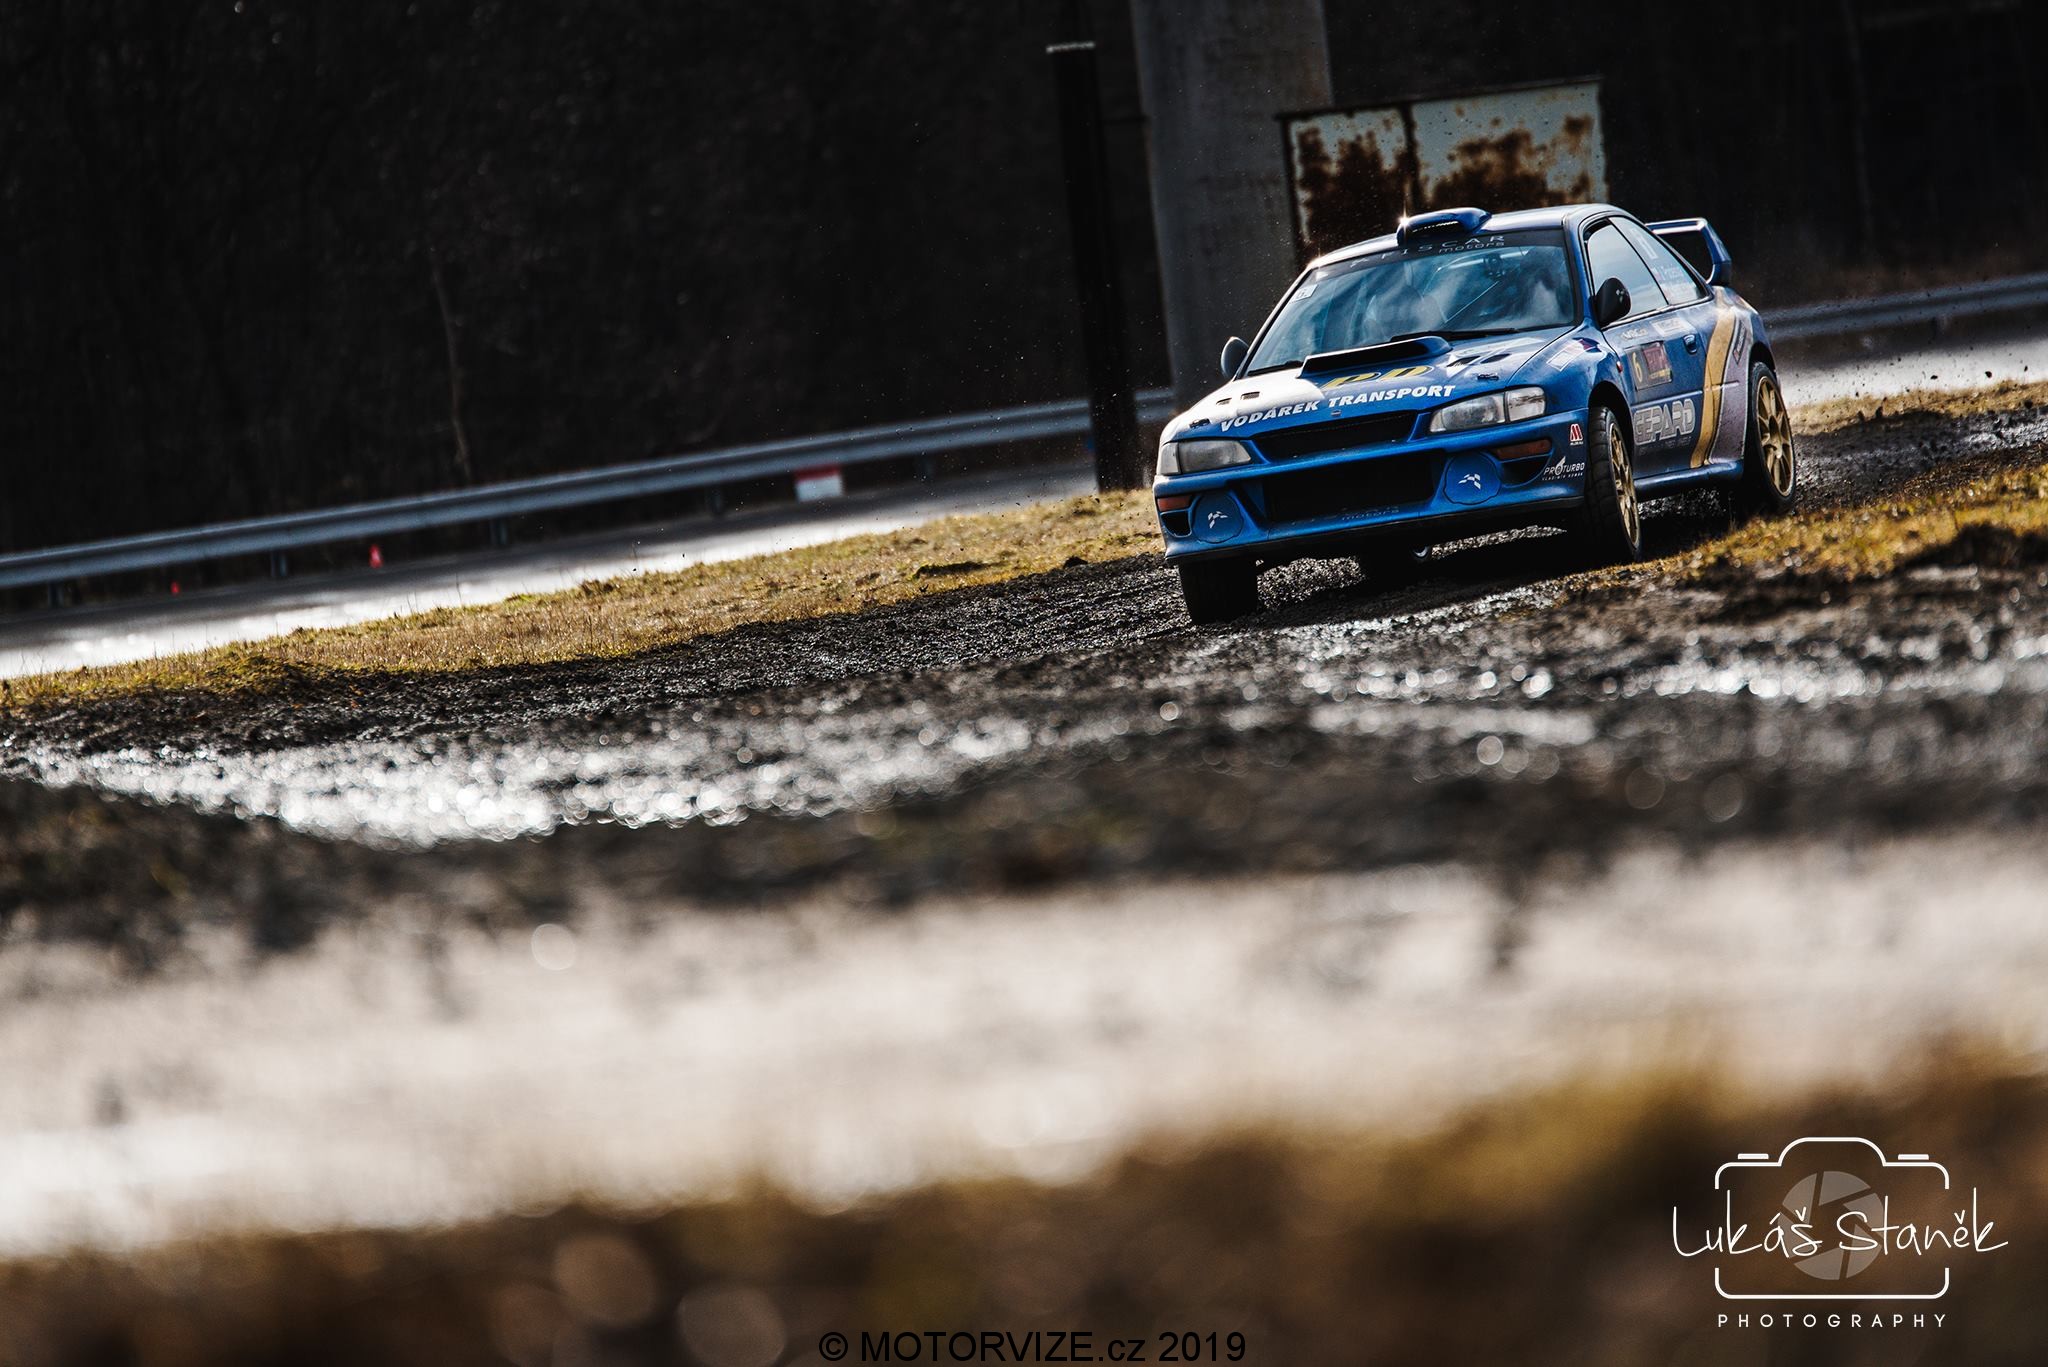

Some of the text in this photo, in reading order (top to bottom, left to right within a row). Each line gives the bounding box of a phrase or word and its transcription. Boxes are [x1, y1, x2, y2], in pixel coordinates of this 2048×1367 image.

[1631, 352, 1644, 383] 6
[1329, 385, 1456, 408] TRANSPORT
[1634, 398, 1695, 446] GEPARD
